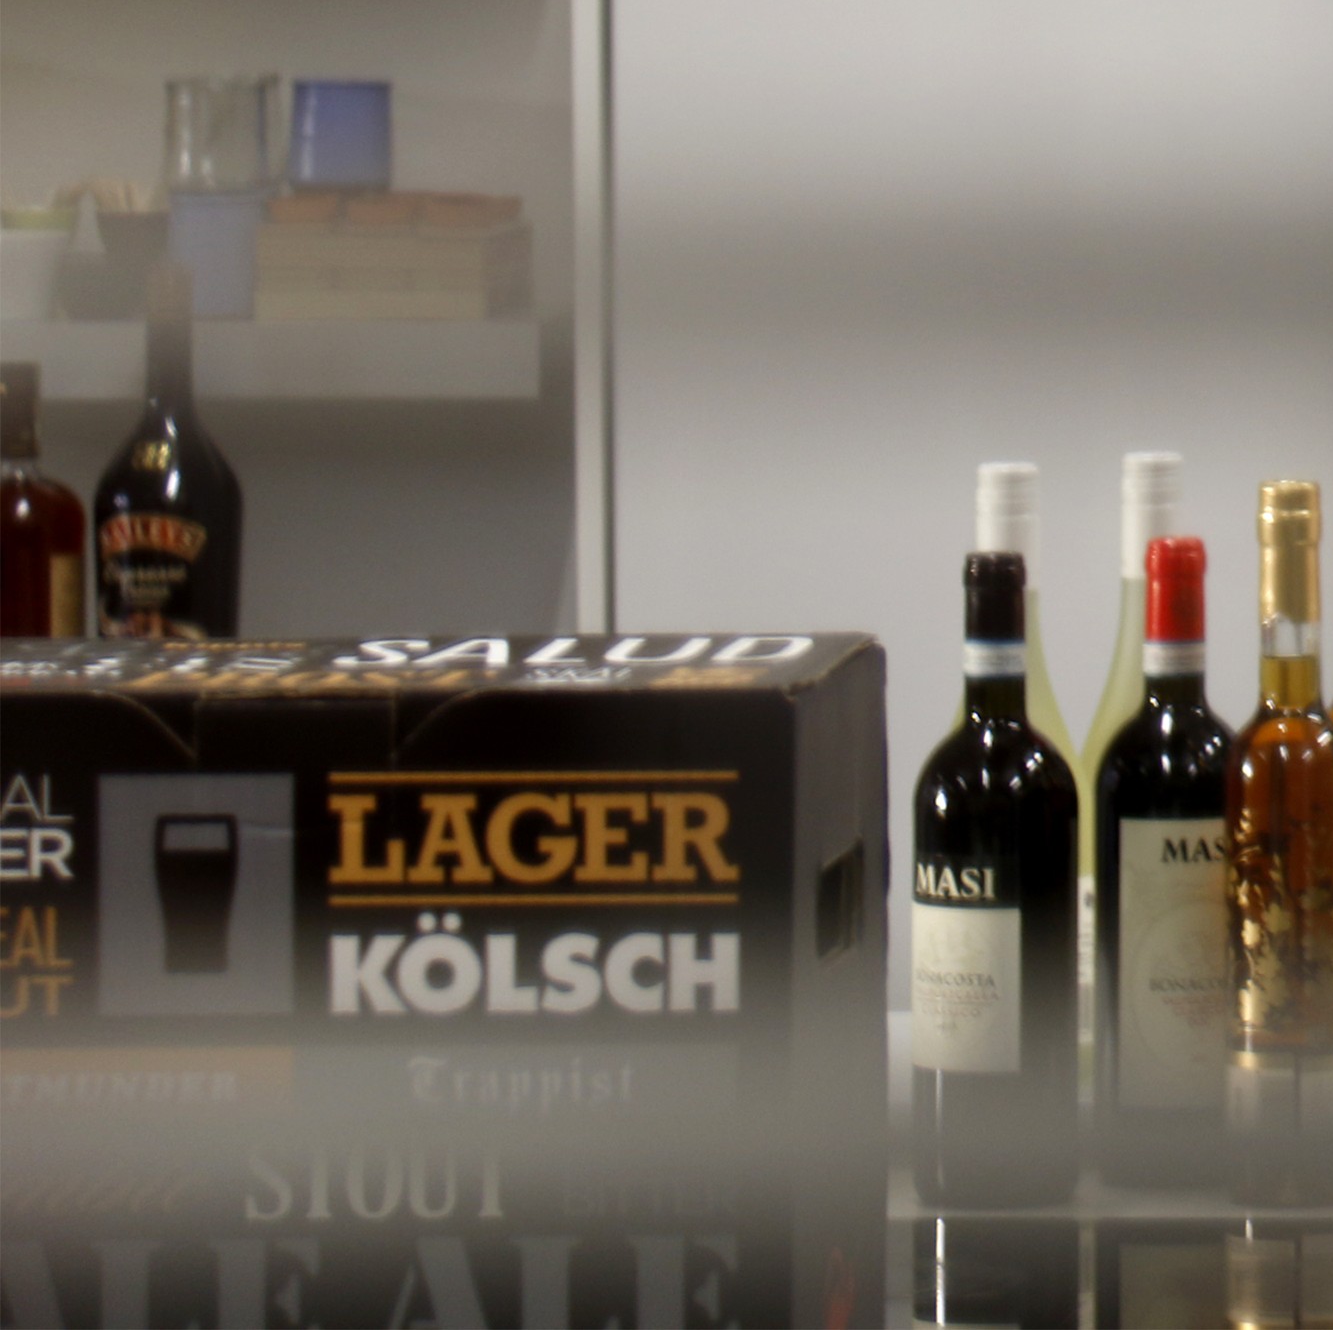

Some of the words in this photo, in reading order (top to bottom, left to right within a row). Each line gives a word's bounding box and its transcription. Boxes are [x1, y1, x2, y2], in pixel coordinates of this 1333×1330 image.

[333, 635, 814, 668] SALUD
[0, 774, 75, 822] AL
[329, 793, 740, 884] LAGER
[1160, 836, 1226, 864] MAS
[915, 861, 997, 900] MASI
[330, 912, 741, 1015] KÖLSCH
[408, 1054, 637, 1112] Trappist
[243, 1144, 506, 1221] STOUT
[386, 1234, 741, 1330] ALE
